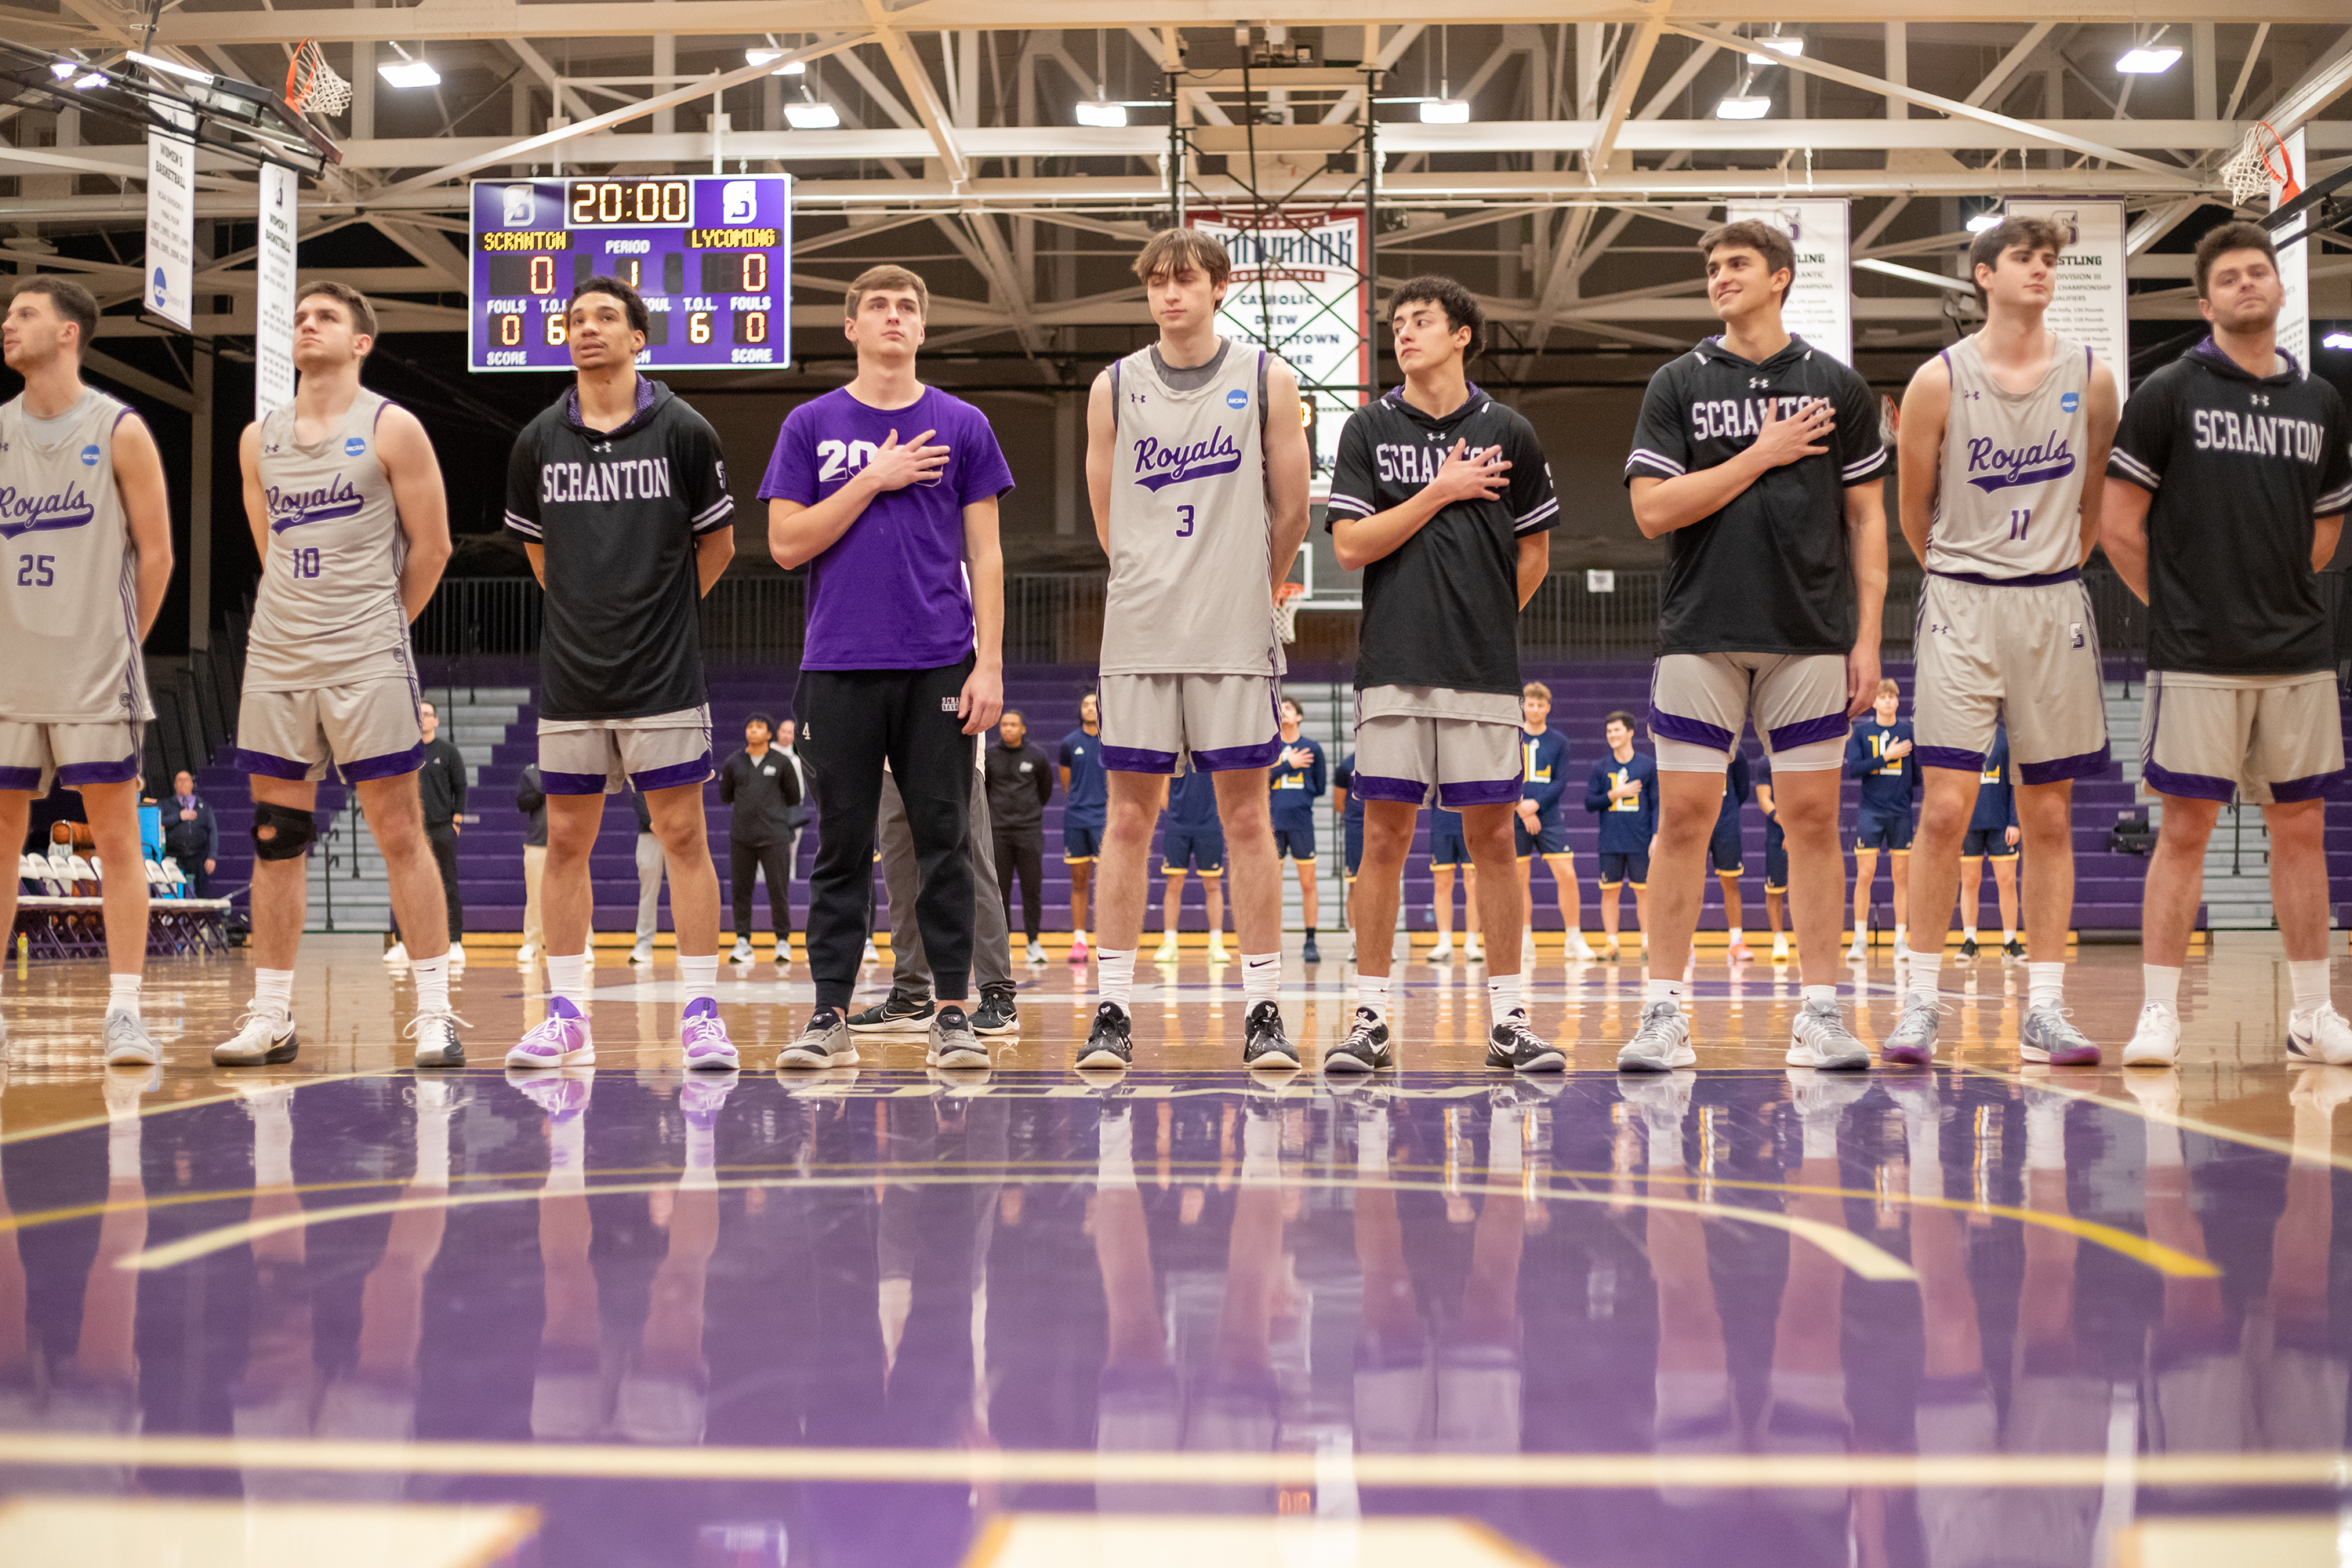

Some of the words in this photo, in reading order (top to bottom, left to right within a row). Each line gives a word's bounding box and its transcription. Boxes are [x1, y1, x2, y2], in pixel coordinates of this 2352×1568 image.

[155, 160, 186, 190] BASKETBALL
[573, 182, 687, 223] 20:00
[484, 230, 567, 251] SCRANTON
[605, 239, 651, 254] PERIOD
[691, 228, 776, 249] LYCOMING
[530, 256, 554, 295] 0
[630, 260, 639, 289] 1
[742, 252, 767, 292] 0
[2057, 256, 2102, 266] STLING
[487, 299, 528, 313] FOULS
[683, 296, 719, 311] T.O.L.
[730, 296, 772, 310] FOULS
[501, 314, 521, 346] 0
[546, 314, 568, 346] 6
[690, 312, 710, 344] 6
[746, 312, 765, 343] 0
[487, 350, 528, 366] SCORE
[731, 348, 773, 363] SCORE
[1134, 425, 1236, 481] Royals
[2195, 410, 2325, 464] SCRANTON
[1967, 429, 2070, 482] Royals
[543, 457, 670, 503] SCRANTON
[265, 472, 359, 523] Royals
[1175, 504, 1196, 539] 3
[2009, 509, 2031, 541] 11
[16, 554, 56, 587] 25
[292, 547, 320, 579] 10
[802, 722, 811, 740] 4
